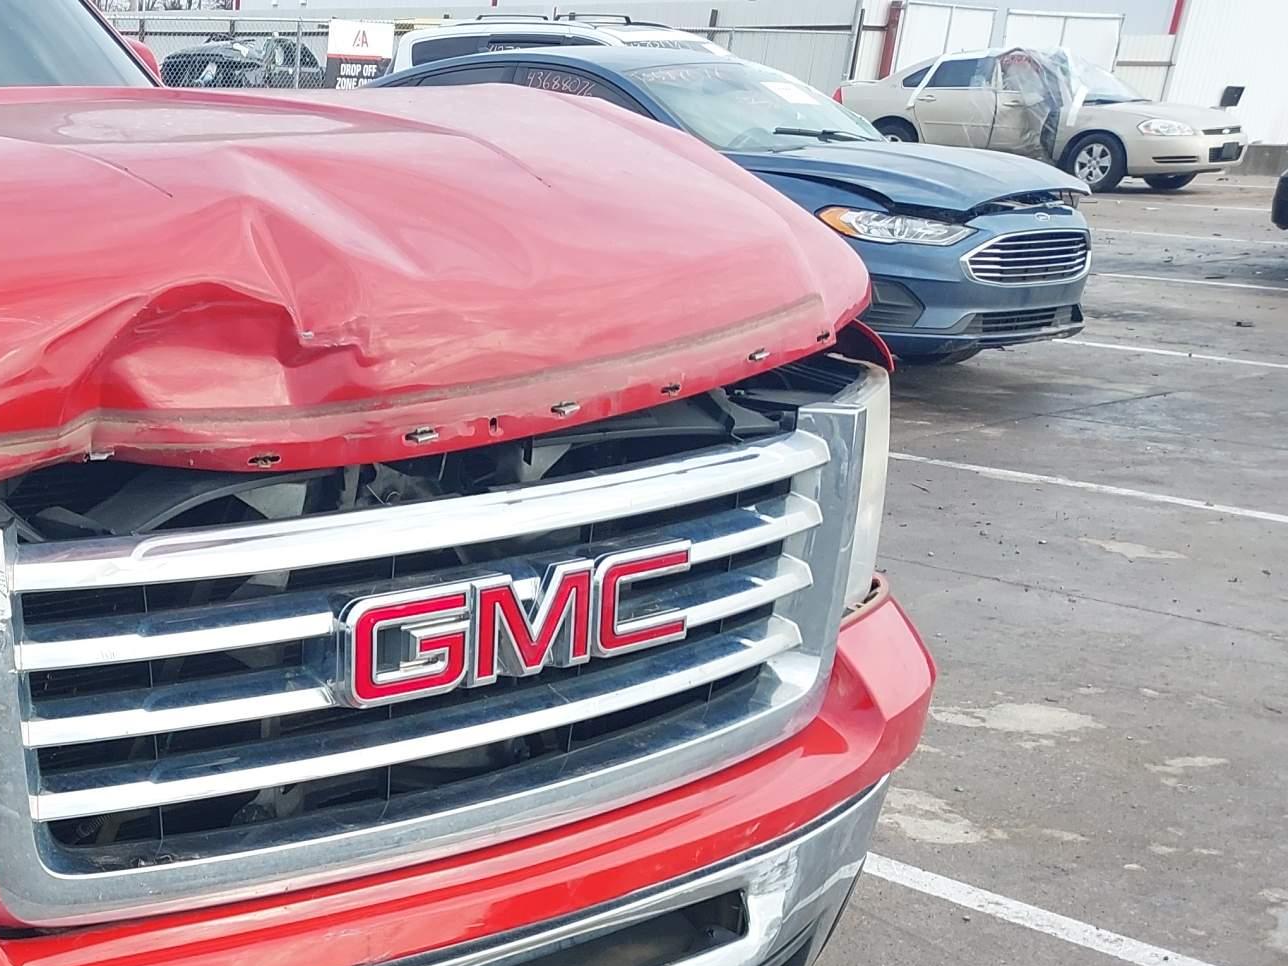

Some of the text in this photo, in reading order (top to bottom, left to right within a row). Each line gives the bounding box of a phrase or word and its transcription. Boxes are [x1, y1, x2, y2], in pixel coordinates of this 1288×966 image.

[340, 63, 378, 77] DROP OFF
[335, 77, 357, 90] ZONE
[344, 539, 692, 708] GMC
